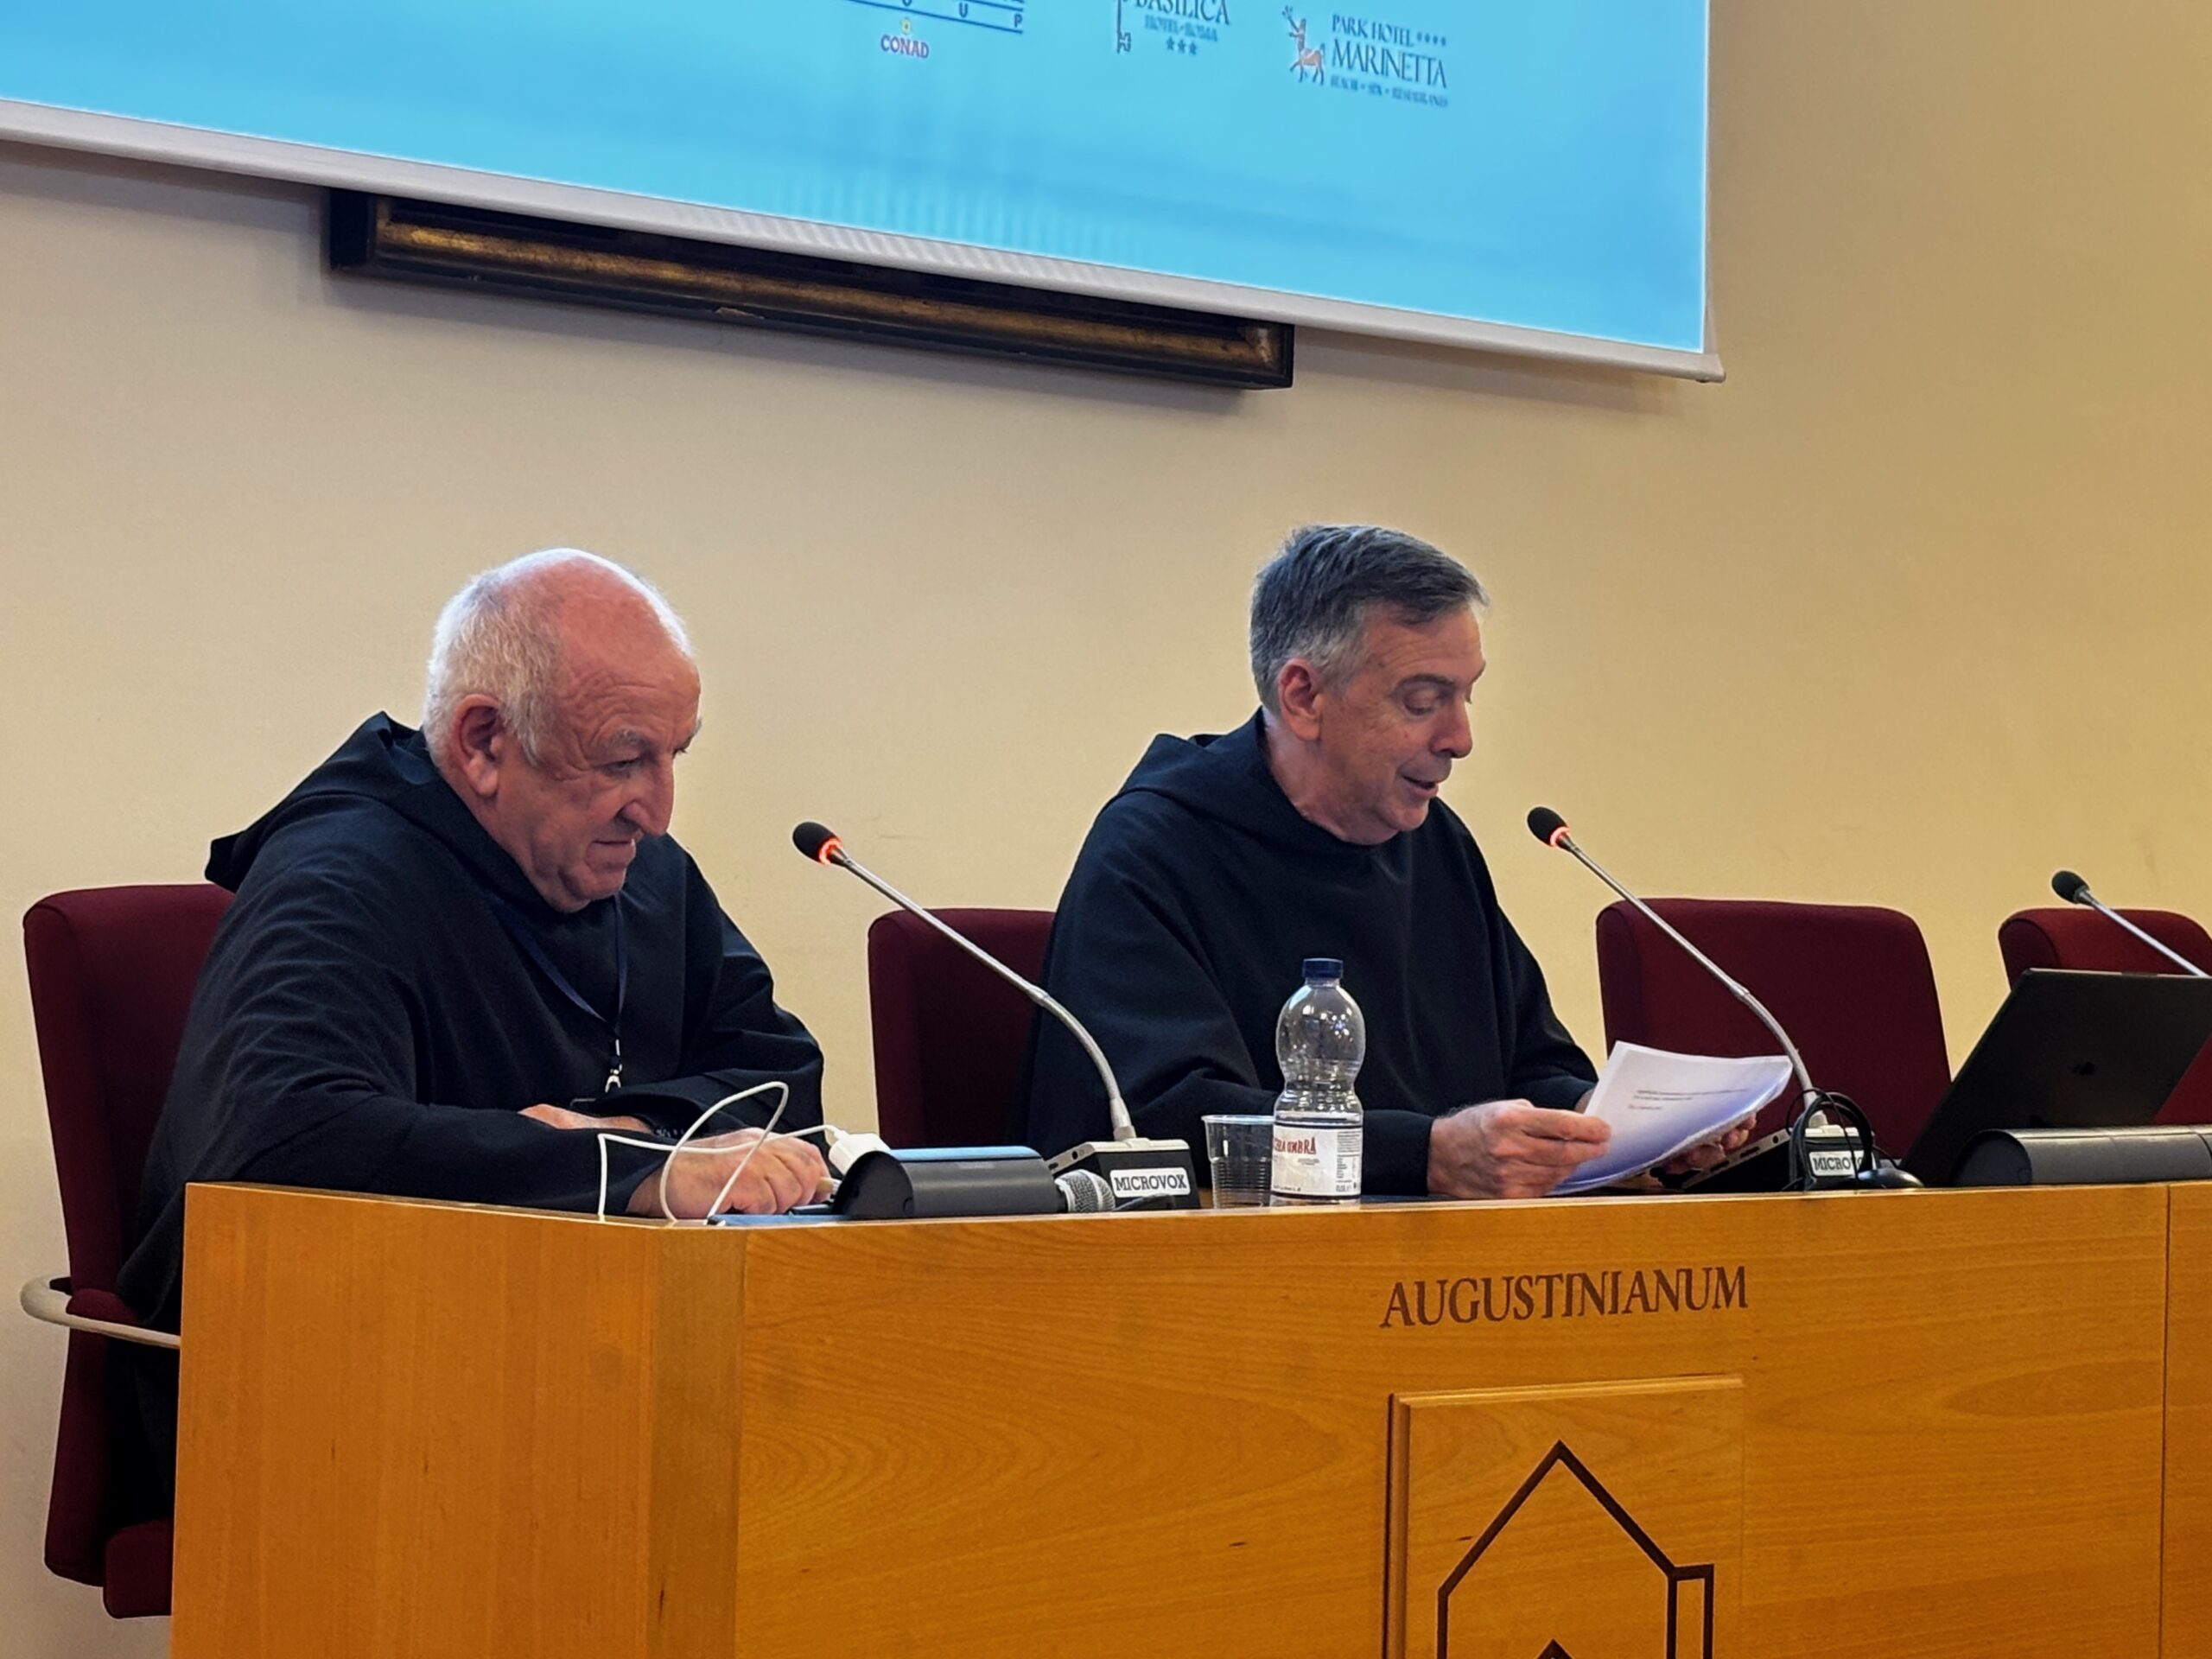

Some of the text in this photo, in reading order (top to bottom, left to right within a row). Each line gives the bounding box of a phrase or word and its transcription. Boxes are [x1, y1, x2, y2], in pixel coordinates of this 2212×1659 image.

[1136, 0, 1230, 25] SILICA
[1332, 14, 1414, 48] PARK HOTEL
[880, 35, 930, 59] CONAD
[1332, 38, 1447, 89] MARINETTA
[1813, 1157, 1863, 1171] MICRO
[1114, 1174, 1187, 1191] MICROVOX
[1379, 1266, 1749, 1329] AUGUSTINIANUM
